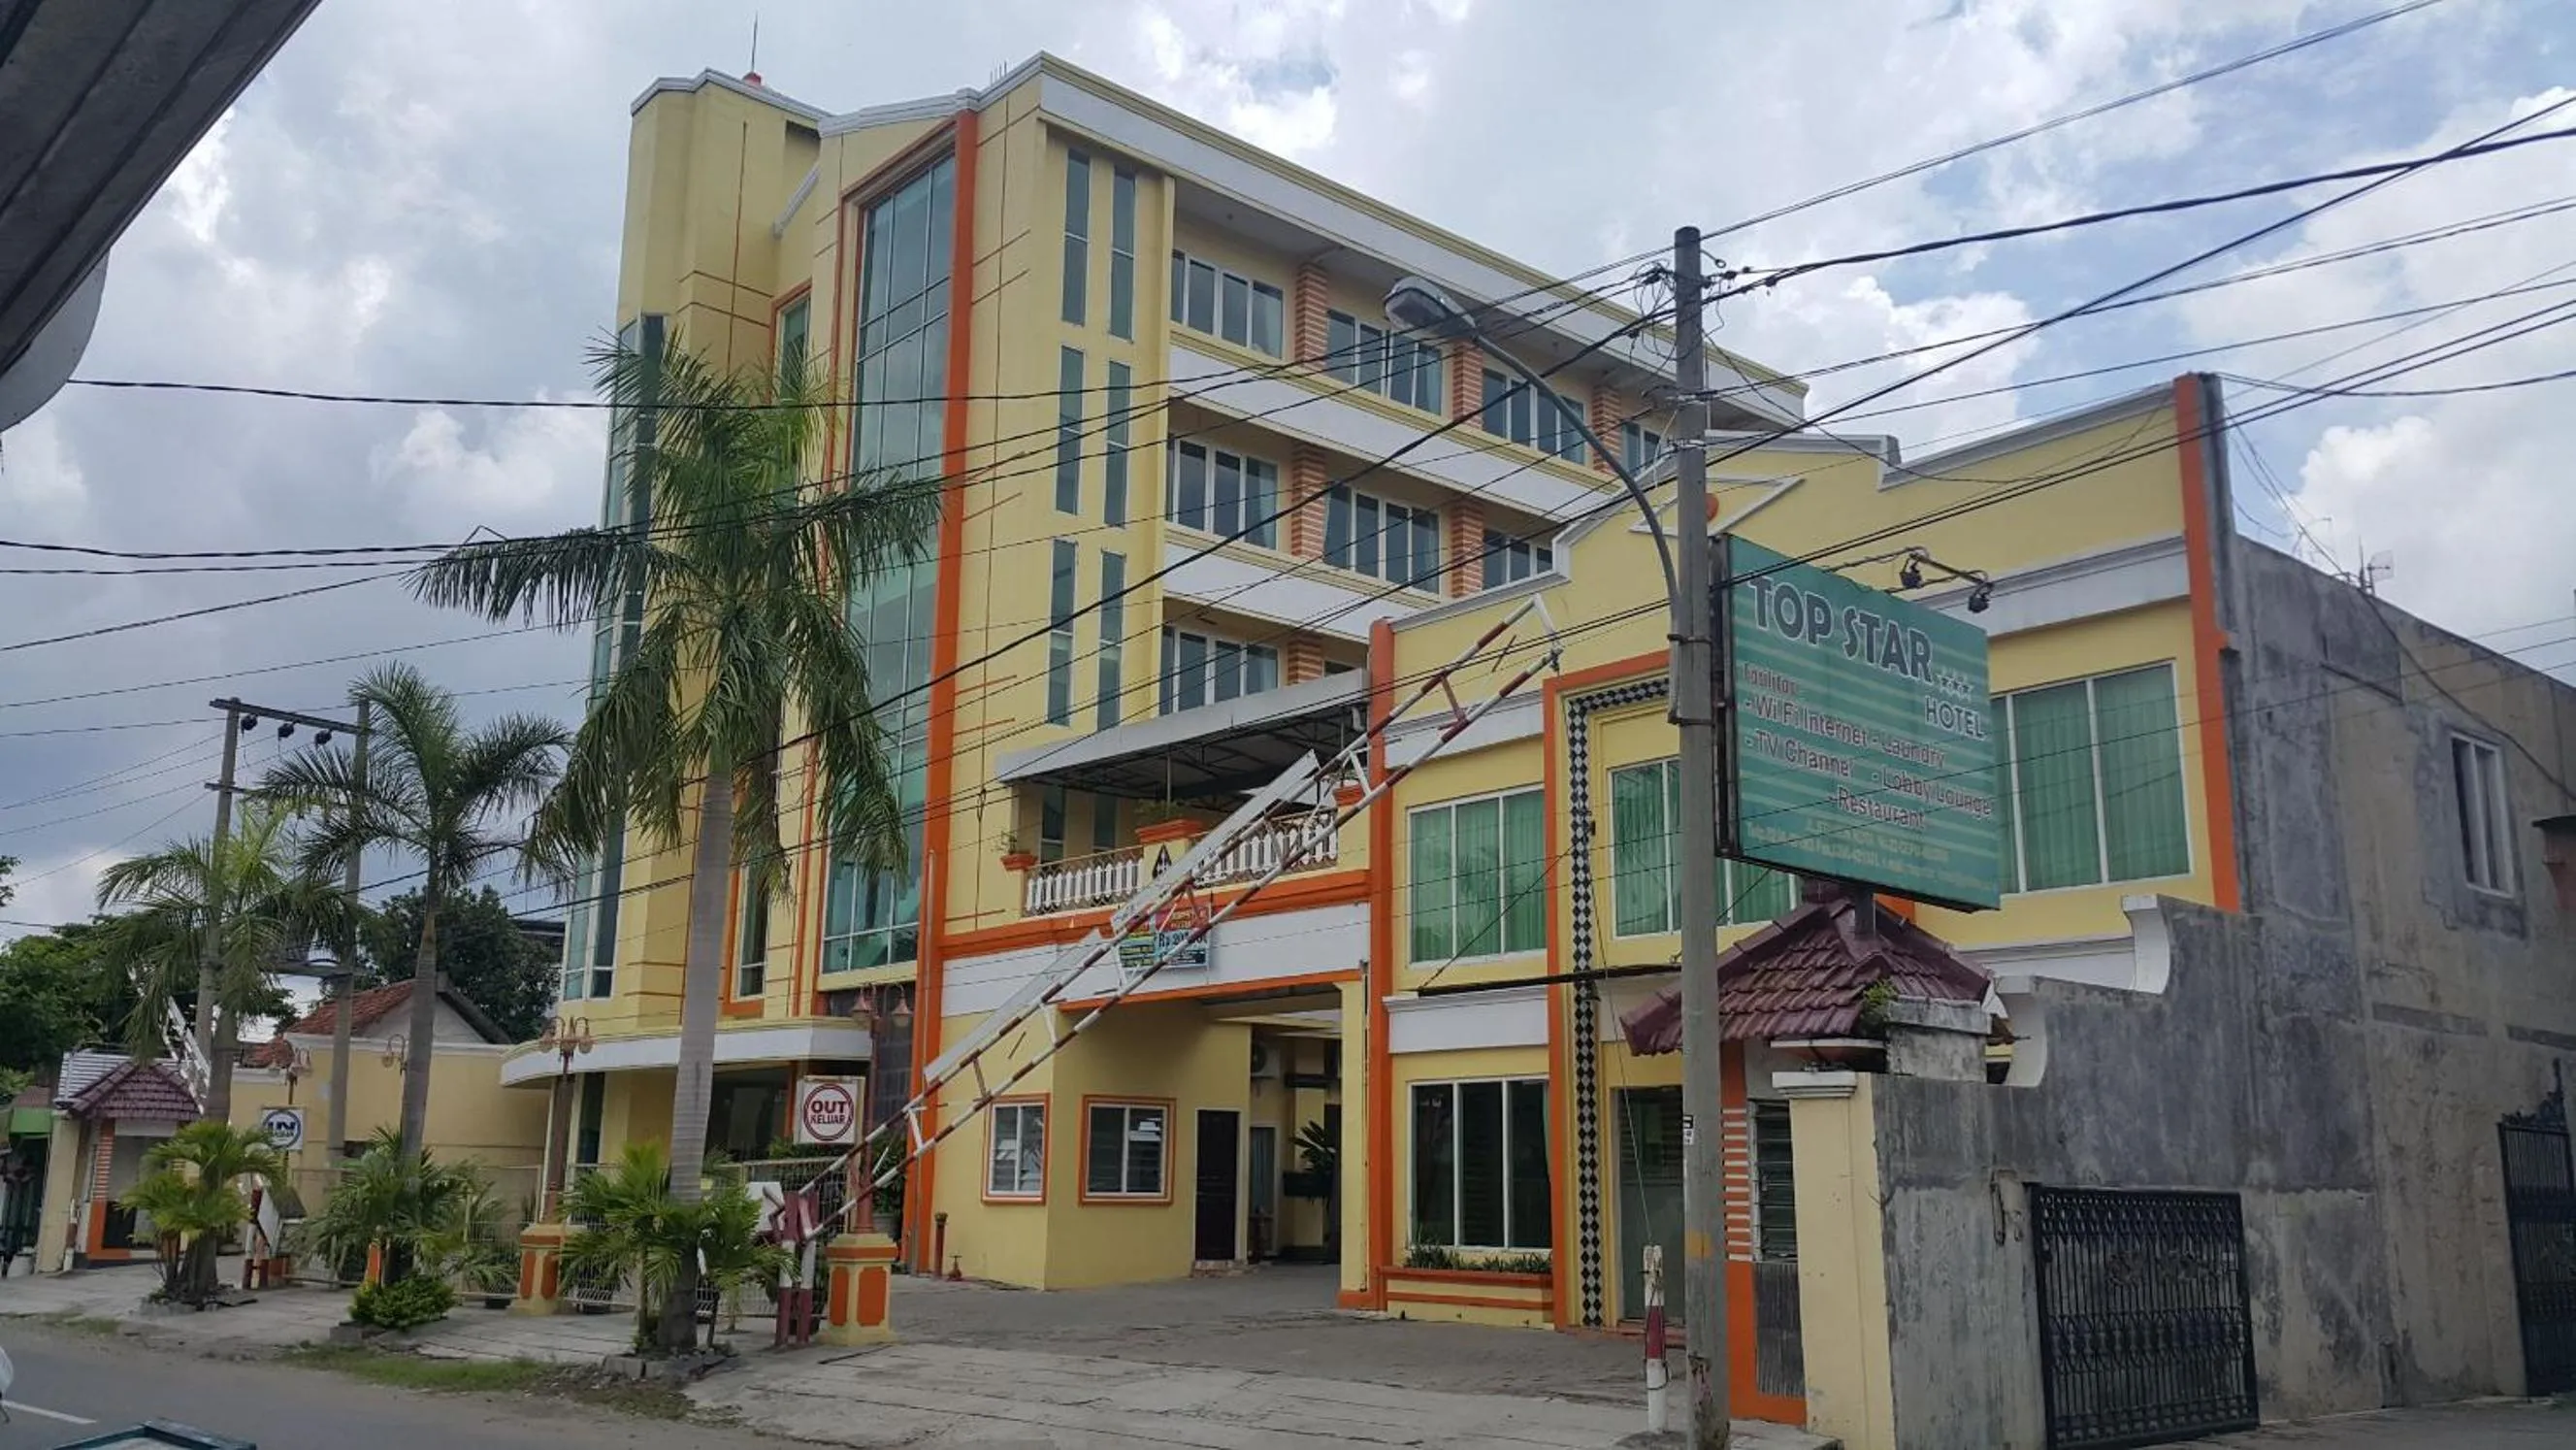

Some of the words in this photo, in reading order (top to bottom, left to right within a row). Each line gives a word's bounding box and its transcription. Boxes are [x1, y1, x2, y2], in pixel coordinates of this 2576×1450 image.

[1747, 576, 1834, 646] TOP
[1842, 606, 1934, 684] STAR
[1803, 707, 1868, 747] Internet
[1924, 695, 1987, 741] HOTEL
[1755, 729, 1779, 758] TV
[1882, 765, 1932, 804] Lobby
[1936, 781, 1992, 819] Lounge
[267, 1121, 296, 1131] IN
[810, 1114, 846, 1125] KELUAR
[811, 1101, 846, 1114] OUT
